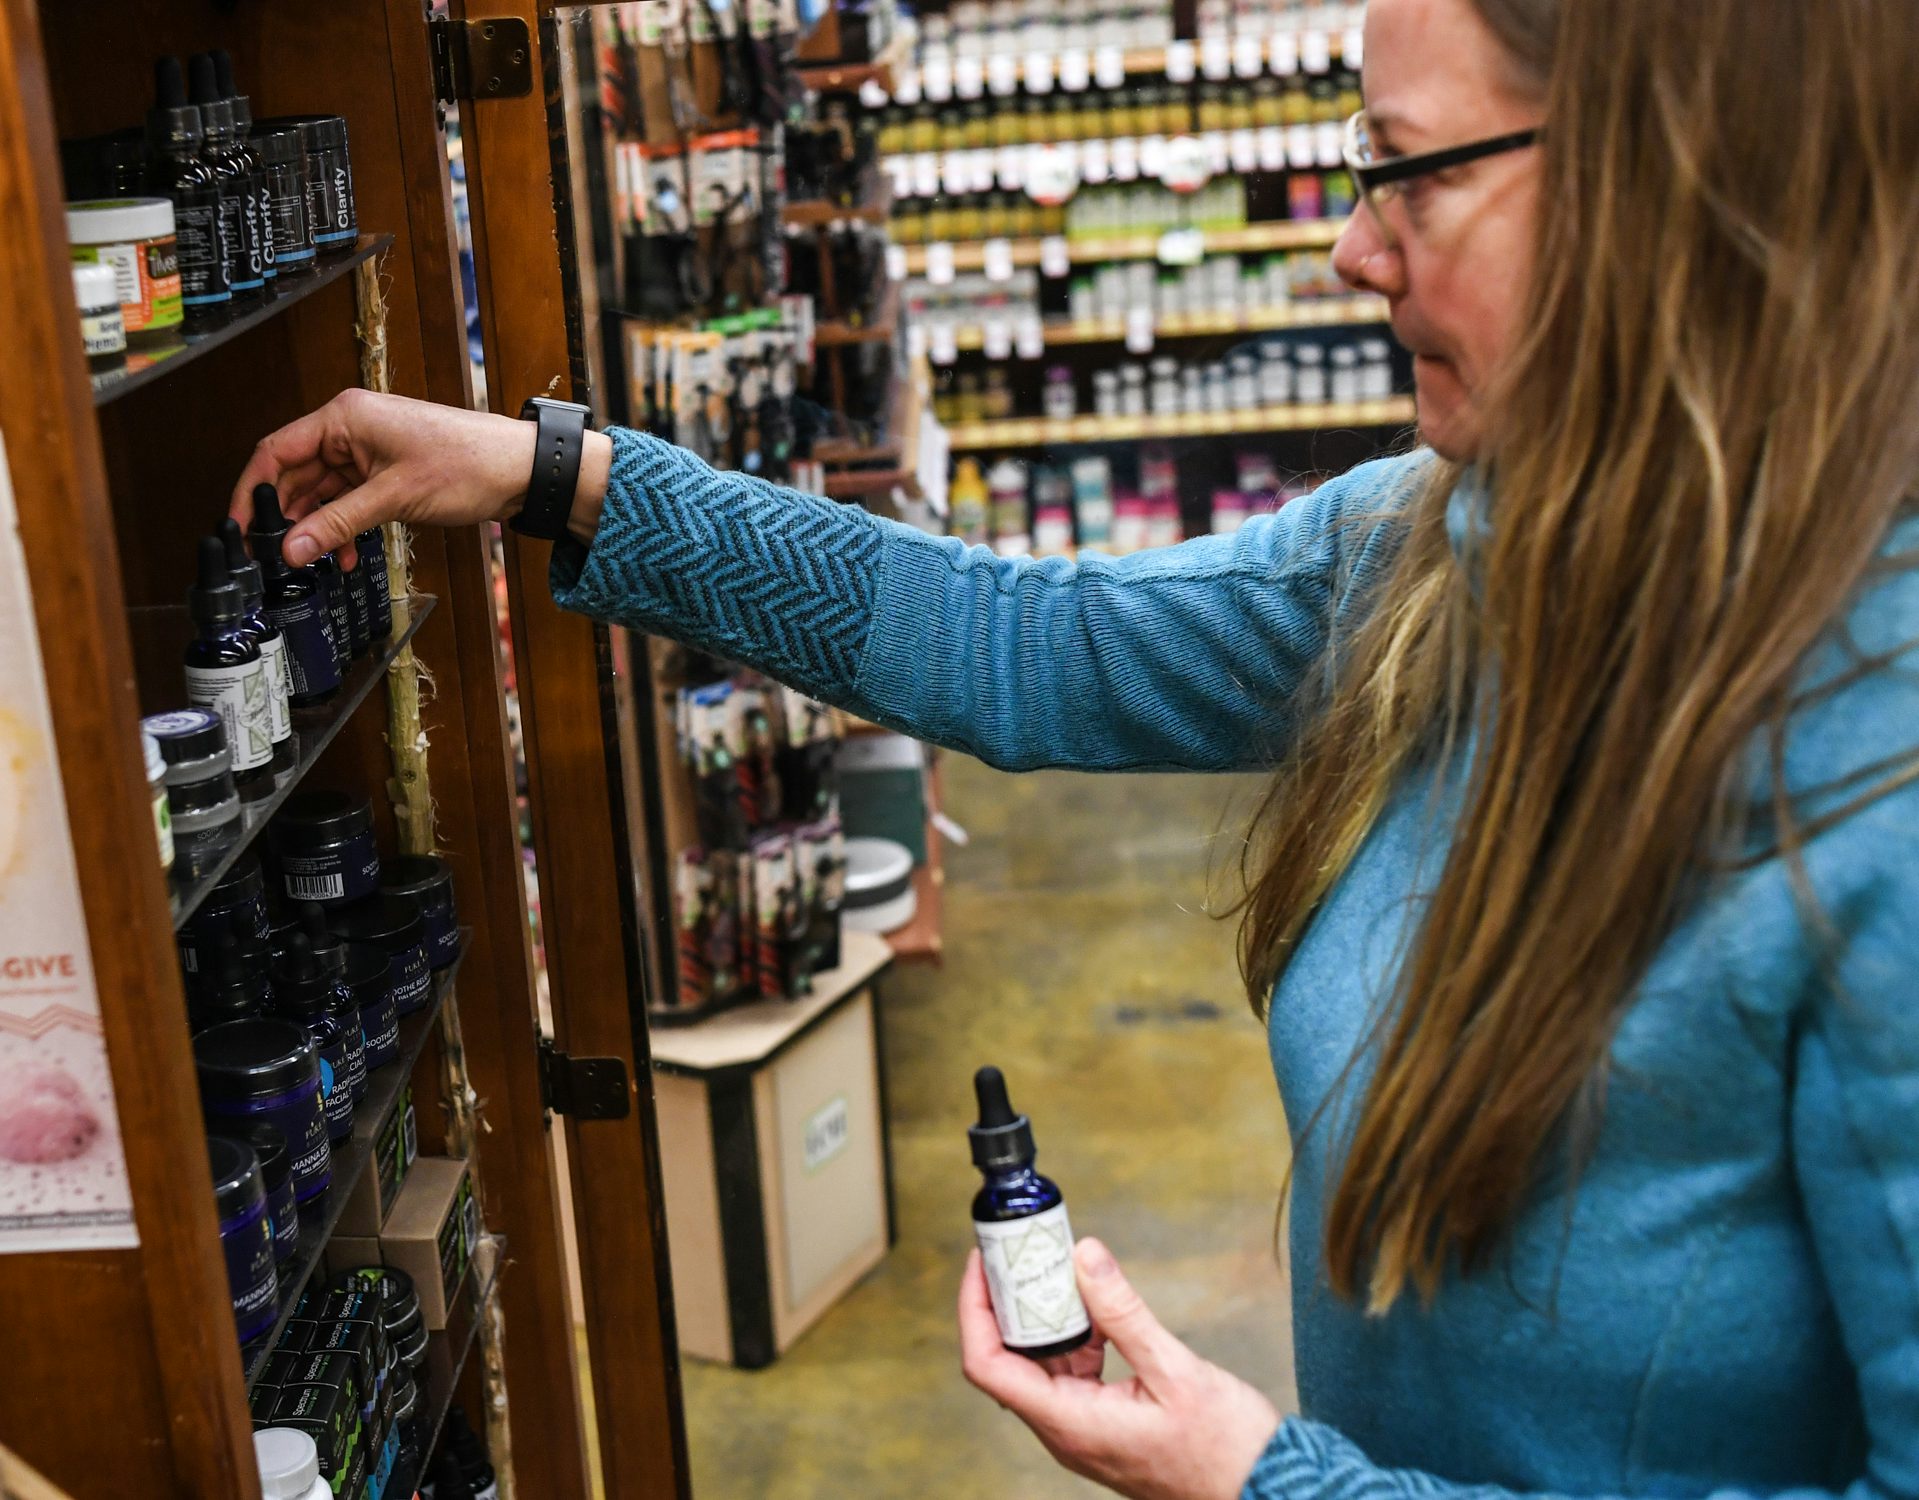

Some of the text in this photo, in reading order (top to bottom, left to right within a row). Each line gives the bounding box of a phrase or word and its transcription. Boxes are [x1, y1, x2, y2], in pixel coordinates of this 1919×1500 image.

[335, 168, 349, 229] Clarify
[246, 195, 262, 273] Clarify
[260, 187, 275, 264] Clarify
[366, 1028, 391, 1049] SOOTHE
[325, 1090, 349, 1108] FACIAL
[338, 1293, 355, 1318] Spectrum
[326, 1322, 343, 1348] Spectrum
[304, 1354, 323, 1380] Spectrum
[292, 1388, 312, 1416] Spectrum
